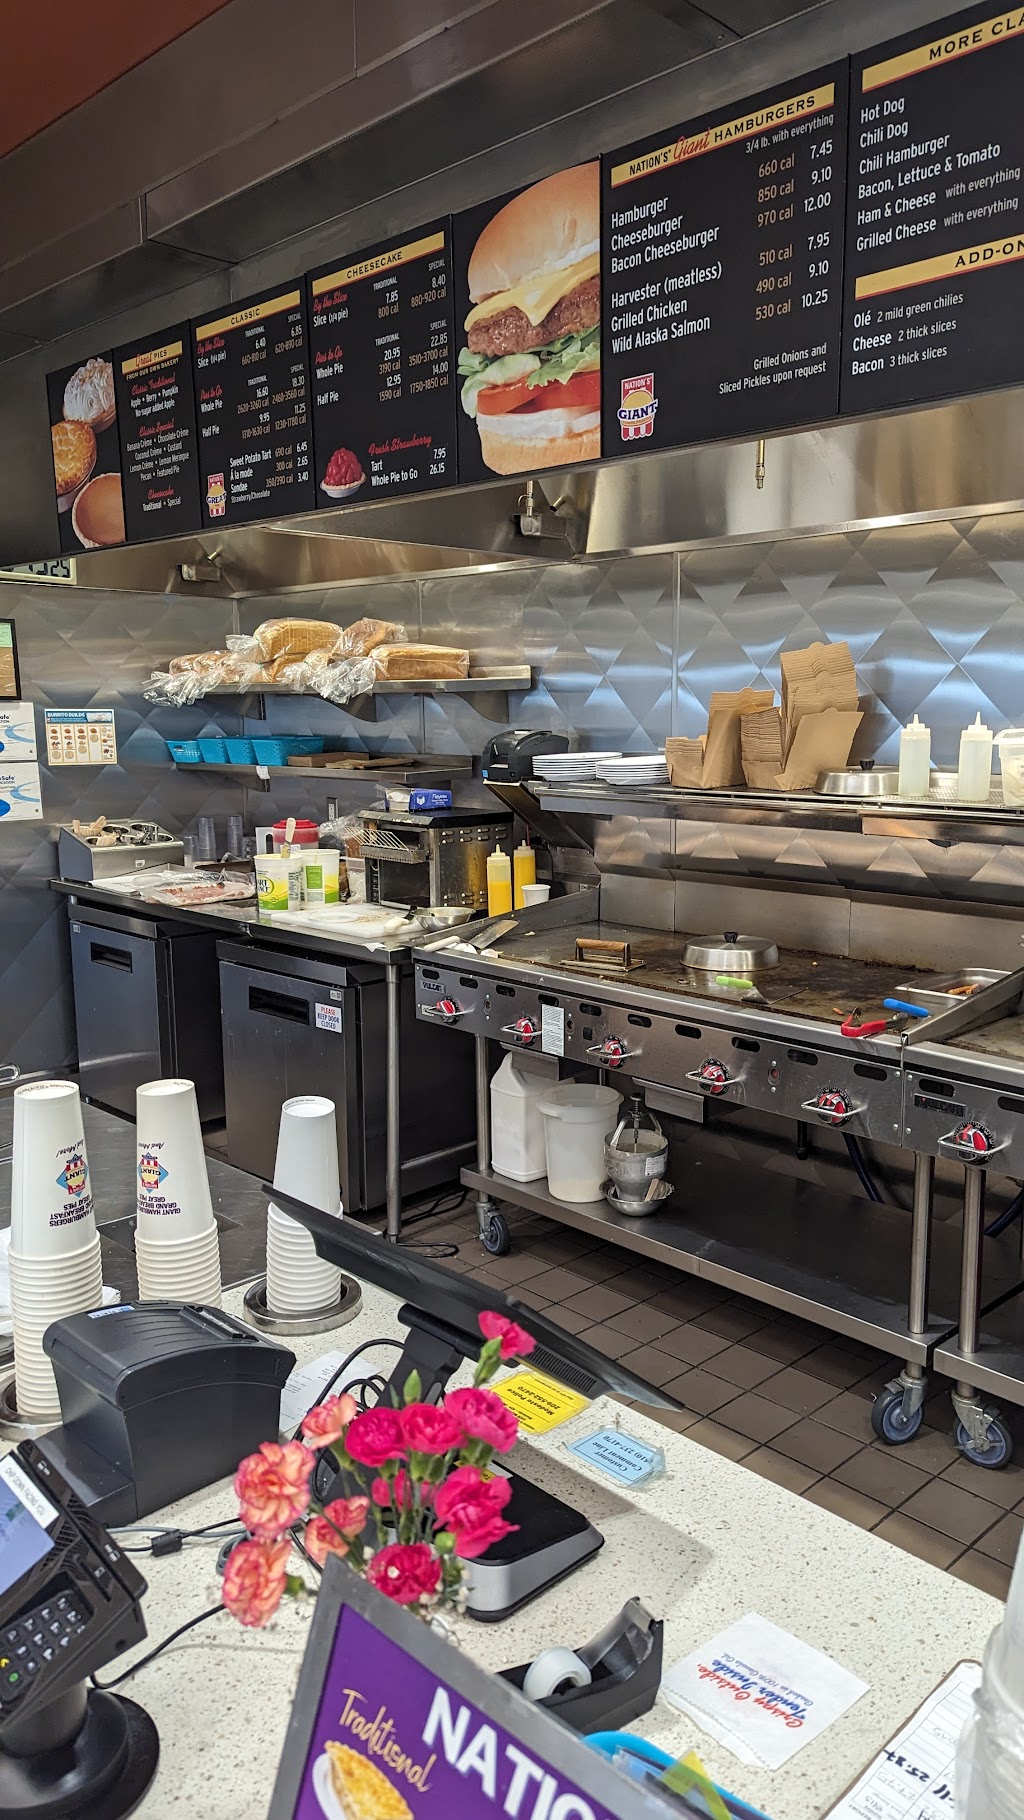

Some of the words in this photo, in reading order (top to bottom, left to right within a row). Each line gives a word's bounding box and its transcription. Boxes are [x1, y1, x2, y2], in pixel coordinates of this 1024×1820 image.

[929, 29, 983, 60] MORE
[861, 104, 880, 123] Hot
[883, 98, 905, 115] Dog
[673, 126, 712, 164] Giant
[714, 95, 815, 143] HAMBURGERS
[745, 141, 760, 154] 3/4
[761, 138, 770, 148] lb.
[773, 131, 789, 143] with
[791, 114, 834, 138] everything
[860, 127, 883, 148] Chili
[887, 122, 908, 139] Dog
[859, 153, 883, 174] Chili
[886, 134, 950, 166] Hamburger
[611, 196, 668, 229] Hamburger
[759, 164, 777, 178] 660
[780, 153, 795, 170] cal
[810, 139, 833, 159] 7.45
[858, 178, 894, 199] Bacon,
[898, 162, 941, 187] Lettuce
[944, 157, 952, 172] &
[956, 143, 1001, 168] Tomato
[611, 214, 684, 251] Cheeseburger
[758, 189, 777, 203] 850
[780, 179, 794, 196] cal
[812, 165, 832, 185] 9.10
[857, 208, 881, 225] Ham
[884, 204, 892, 218] &
[895, 192, 936, 213] Cheese
[946, 182, 966, 198] with
[968, 167, 1021, 192] everything
[611, 254, 641, 274] Bacon
[644, 225, 719, 262] Cheeseburger
[758, 212, 776, 228] 970
[779, 204, 794, 220] cal
[803, 192, 831, 213] 12.00
[856, 228, 892, 251] Grilled
[895, 219, 937, 241] Cheese
[944, 211, 964, 227] with
[966, 197, 1019, 222] everything
[347, 251, 403, 279] CHEESECAKE
[373, 276, 398, 291] TRADITIONAL
[428, 259, 445, 271] SPECIAL
[611, 281, 661, 309] Harvester
[664, 261, 722, 295] (meatless)
[759, 252, 776, 266] 510
[778, 244, 793, 260] cal
[808, 231, 830, 252] 7.95
[386, 290, 399, 304] 7.85
[432, 274, 446, 288] 8.40
[611, 309, 644, 332] Grilled
[646, 299, 687, 322] Chicken
[756, 279, 775, 294] 490
[778, 272, 792, 288] cal
[809, 260, 829, 278] 9.10
[231, 309, 260, 325] CLASSIC
[313, 314, 327, 327] Slice
[338, 308, 349, 322] pie)
[612, 333, 632, 354] Wild
[635, 327, 668, 349] Alaska
[671, 316, 711, 339] Salmon
[756, 306, 774, 320] 530
[777, 299, 791, 315] cal
[801, 289, 828, 308] 10.25
[854, 310, 872, 328] Olé
[877, 311, 883, 323] 2
[885, 306, 903, 321] mild
[906, 301, 932, 318] green
[934, 293, 964, 310] chilies
[376, 333, 400, 346] TRADITIONAL
[430, 319, 447, 331] SPECIAL
[384, 346, 401, 361] 20.95
[431, 332, 448, 348] 22.85
[853, 333, 892, 352] Cheese
[898, 330, 904, 342] 2
[906, 325, 928, 340] thick
[931, 319, 957, 335] slices
[154, 349, 167, 360] PIES
[198, 357, 209, 368] Slice
[754, 354, 779, 371] Grilled
[781, 348, 809, 364] Onions
[811, 343, 827, 357] and
[852, 358, 884, 375] Bacon
[890, 356, 896, 367] 3
[898, 351, 919, 365] thick
[922, 346, 948, 361] slices
[126, 372, 138, 380] FROM
[161, 358, 179, 369] BAKERY
[316, 364, 333, 380] Whole
[334, 363, 344, 375] Pie
[387, 374, 401, 387] 12.95
[432, 361, 448, 375] 14.00
[719, 379, 741, 395] Sliced
[743, 373, 771, 390] Pickles
[773, 369, 793, 385] upon
[795, 360, 827, 379] request
[214, 399, 223, 410] Pie
[317, 393, 329, 406] Half
[330, 391, 339, 403] Pie
[619, 401, 657, 419] GIANT
[212, 425, 220, 436] Pie
[230, 457, 244, 468] Sweet
[245, 452, 261, 465] Potato
[262, 449, 272, 460] Tart
[296, 441, 308, 452] 6.45
[240, 467, 253, 478] mode
[297, 457, 308, 467] 2.65
[371, 460, 383, 472] Tart
[434, 447, 446, 460] 7.95
[298, 472, 309, 482] 3.40
[371, 473, 389, 487] Whole
[391, 472, 399, 484] Pie
[401, 471, 408, 481] to
[409, 468, 418, 479] Go
[507, 1388, 526, 1401] Police
[592, 1442, 609, 1452] Line
[609, 1451, 642, 1471] Comment
[594, 1451, 628, 1472] Customer
[711, 1659, 758, 1690] Inside
[735, 1659, 758, 1675] Canola
[697, 1663, 750, 1701] Outside.
[753, 1696, 804, 1728] Crispy
[759, 1687, 807, 1720] Tender
[786, 1691, 814, 1707] Cooked
[338, 1688, 438, 1793] Traditional
